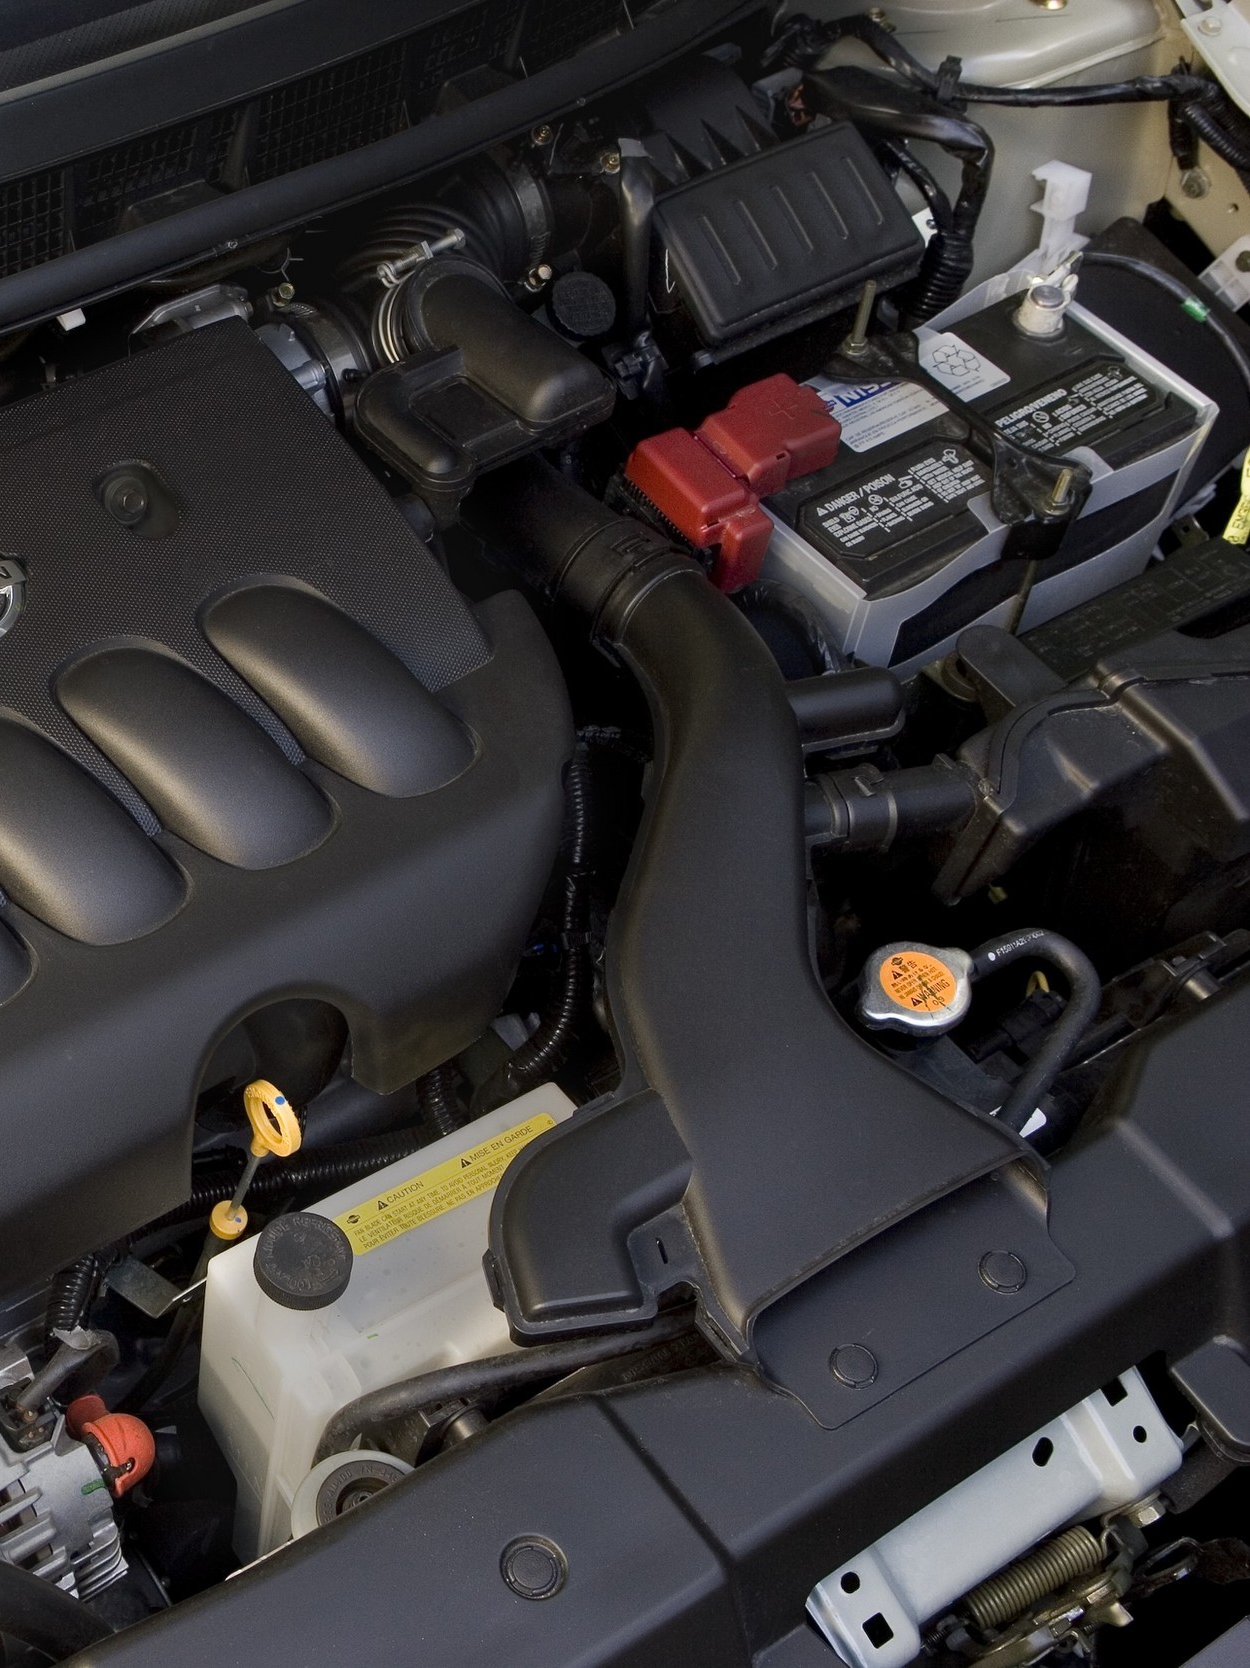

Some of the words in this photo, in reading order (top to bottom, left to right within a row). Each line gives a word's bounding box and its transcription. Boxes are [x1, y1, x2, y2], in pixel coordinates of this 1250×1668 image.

[823, 490, 860, 511] DANGER
[861, 473, 896, 493] POISON
[468, 1146, 490, 1162] MISE
[490, 1138, 504, 1151] EN
[503, 1124, 533, 1144] GARDE
[385, 1179, 424, 1205] CAUTION
